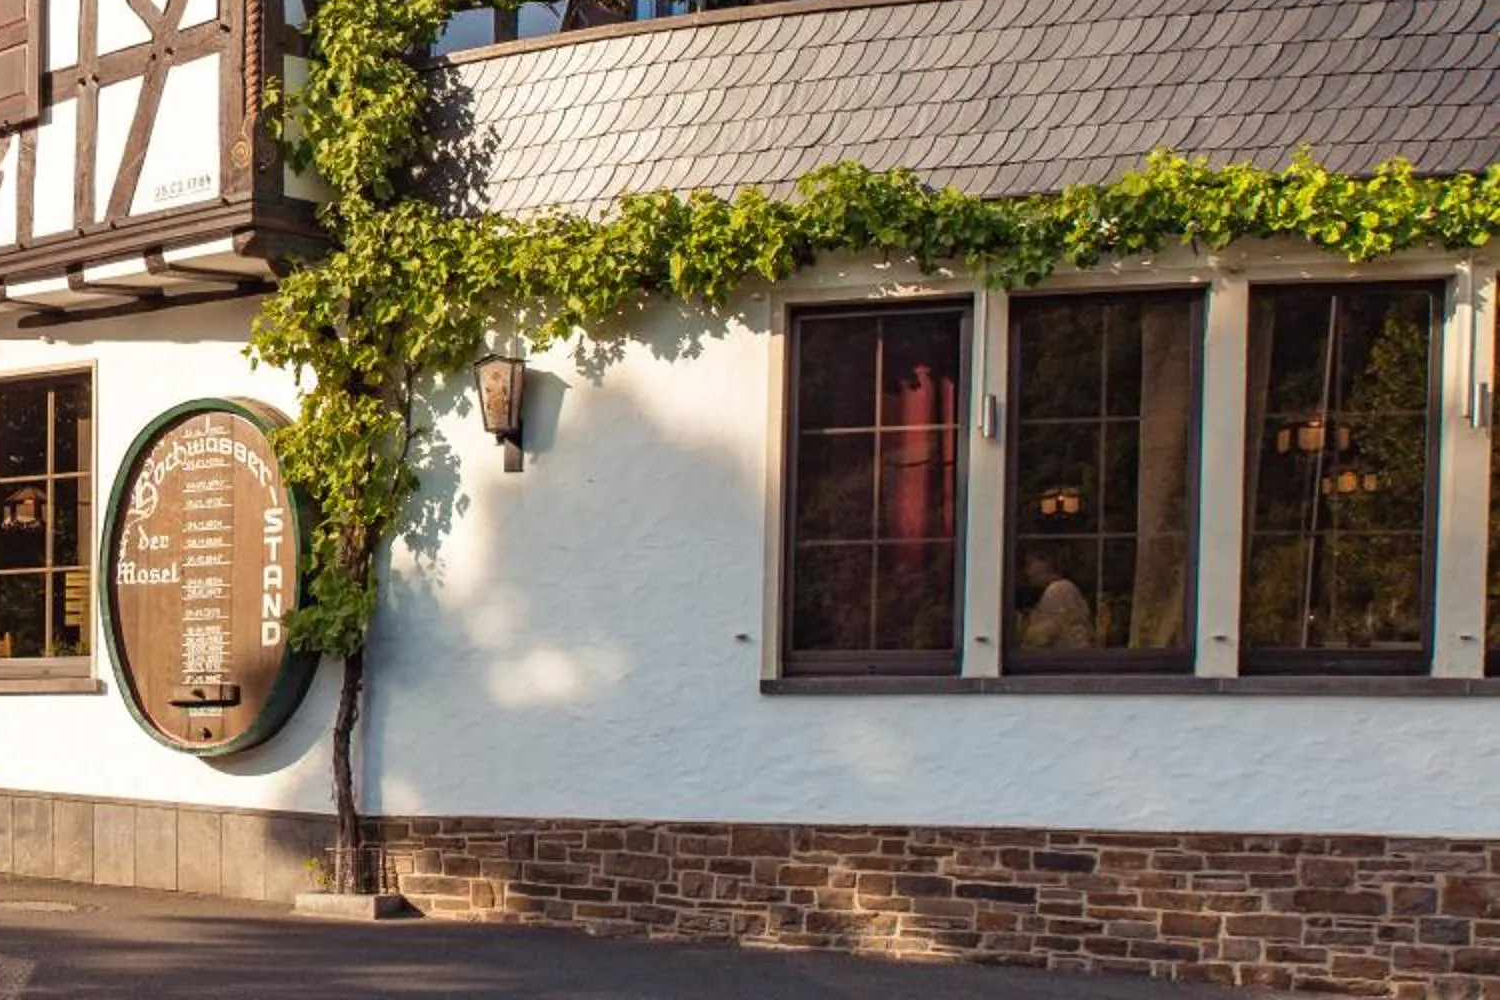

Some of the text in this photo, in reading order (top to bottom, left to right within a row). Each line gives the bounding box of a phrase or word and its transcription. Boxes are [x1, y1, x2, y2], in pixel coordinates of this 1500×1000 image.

[137, 525, 170, 551] der
[115, 561, 180, 585] Mosel
[261, 507, 284, 647] STAND
